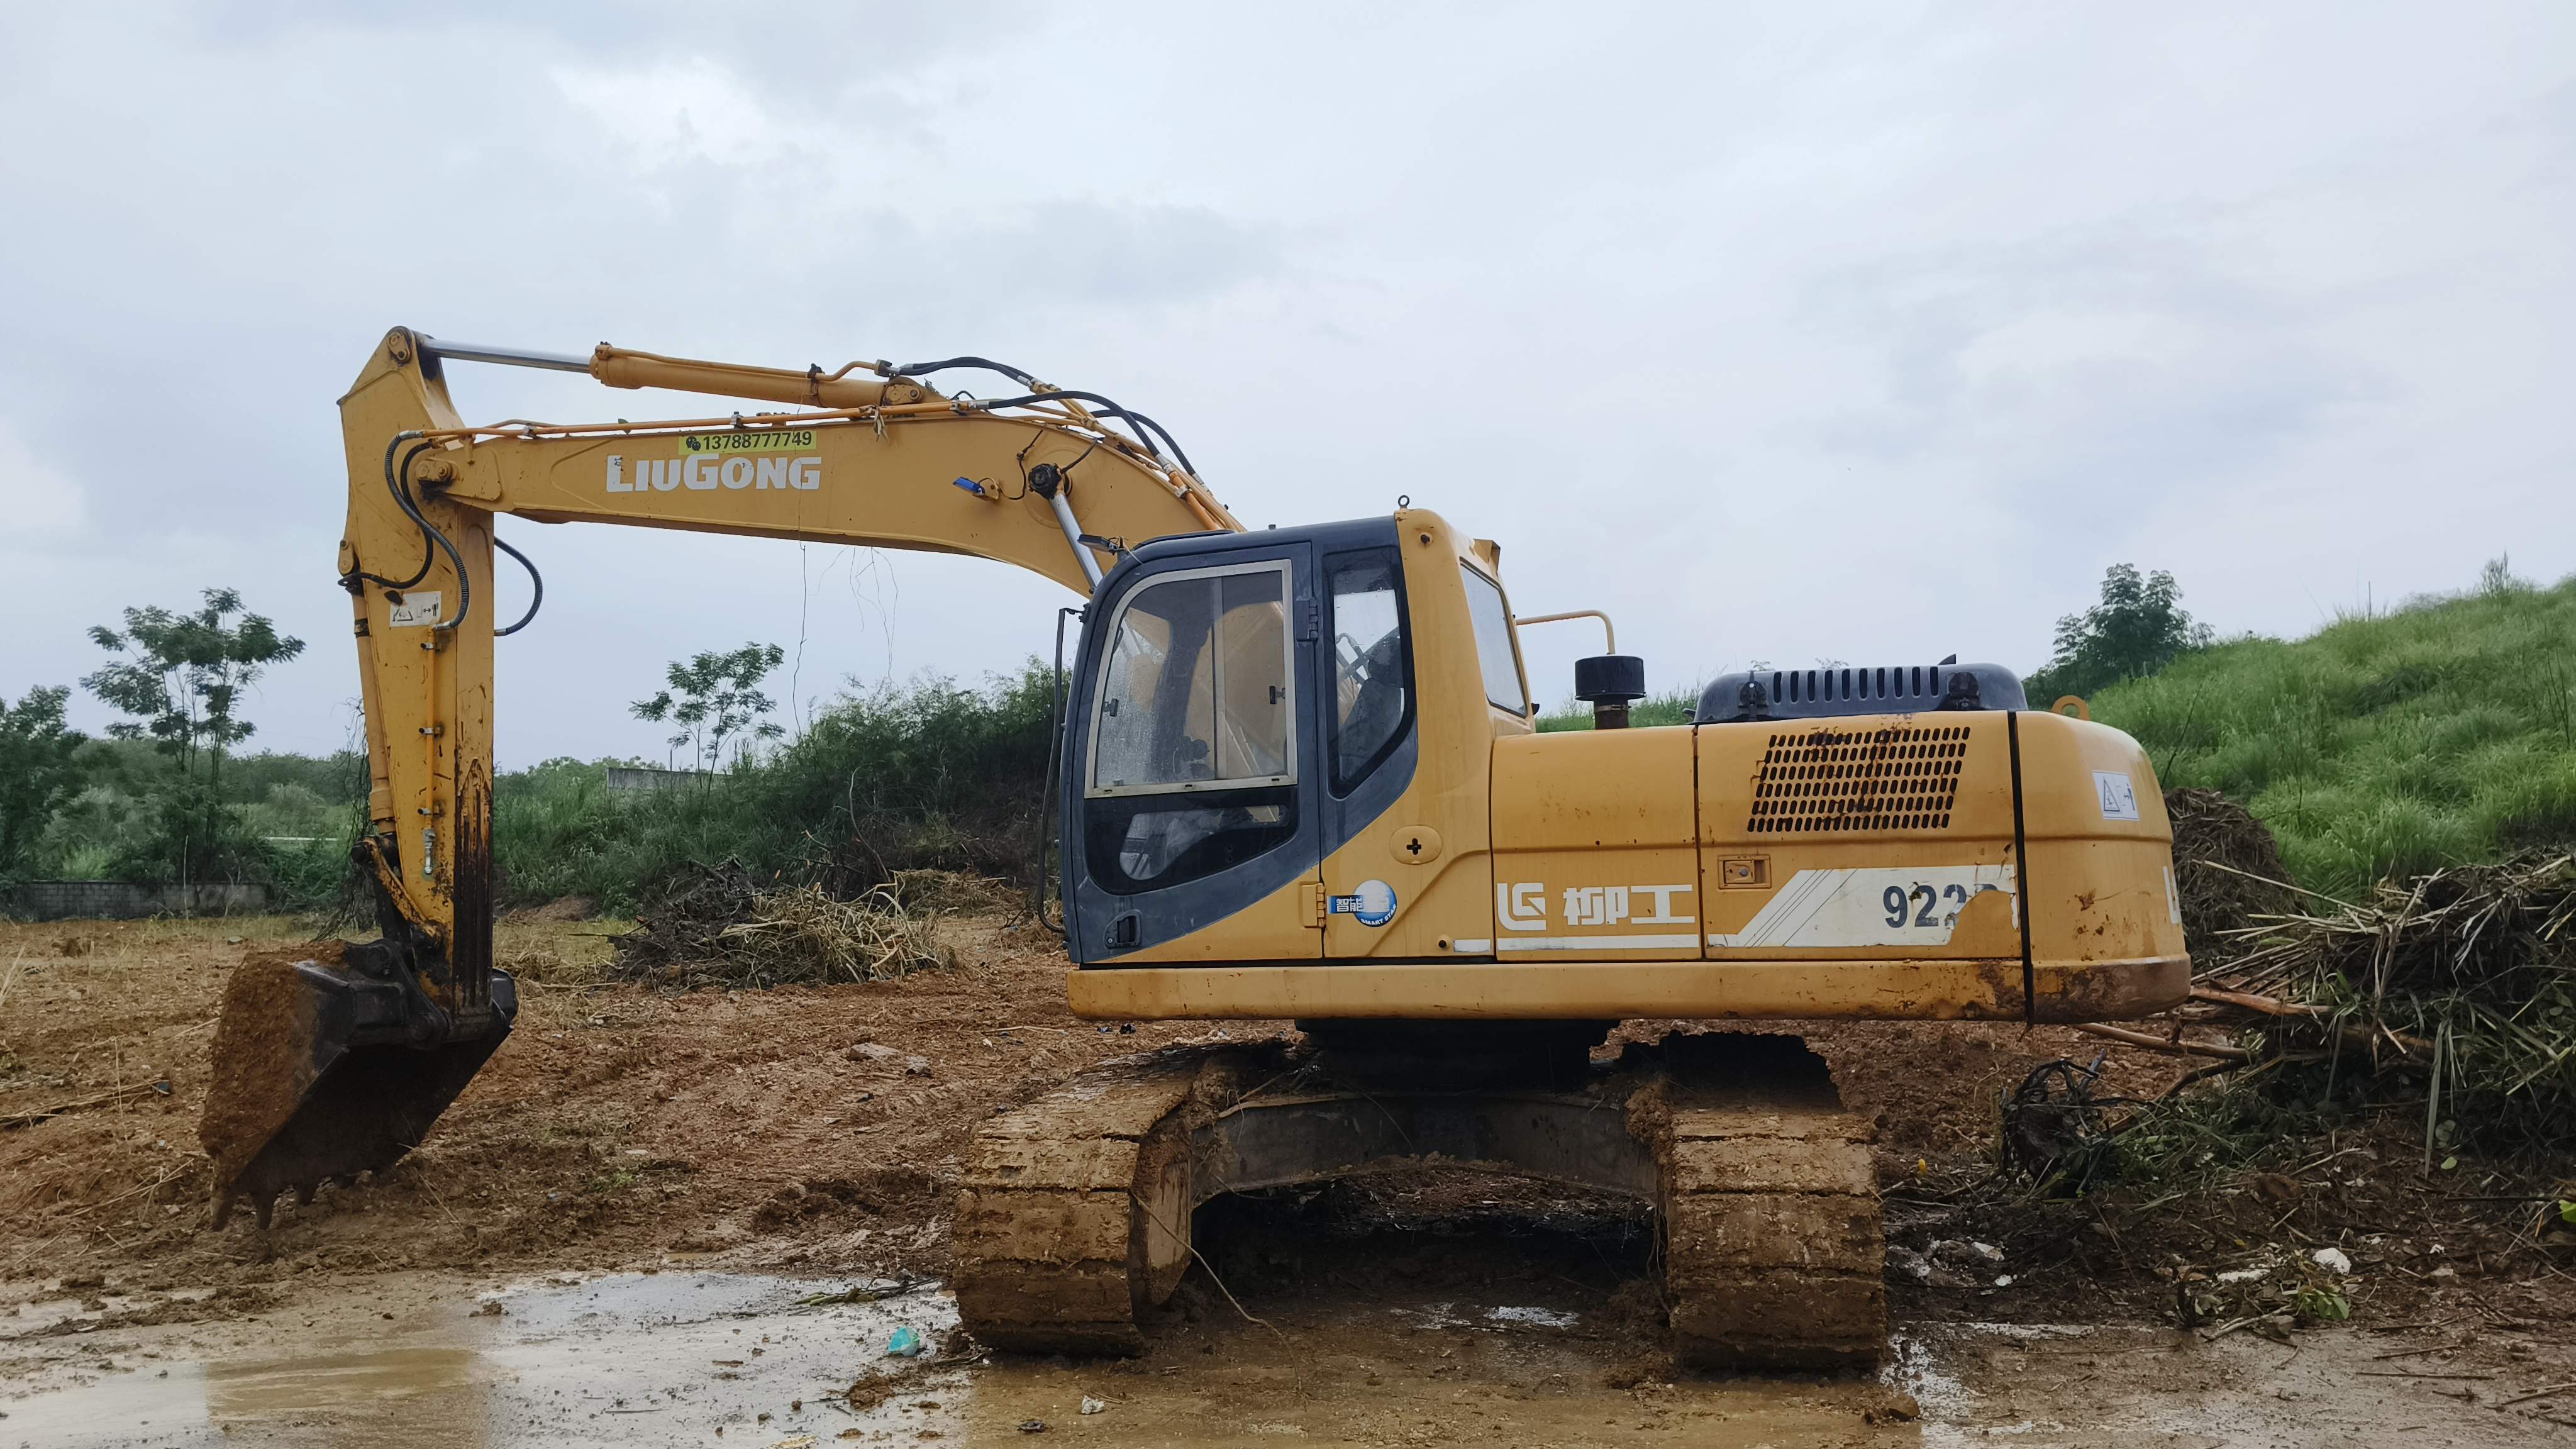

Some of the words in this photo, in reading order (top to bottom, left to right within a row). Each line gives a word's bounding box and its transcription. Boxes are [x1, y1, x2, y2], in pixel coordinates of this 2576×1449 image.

[703, 431, 812, 450] 13788777749
[606, 453, 822, 492] LIUGONG
[1563, 884, 1696, 926] 柳工
[1883, 884, 1998, 928] 922
